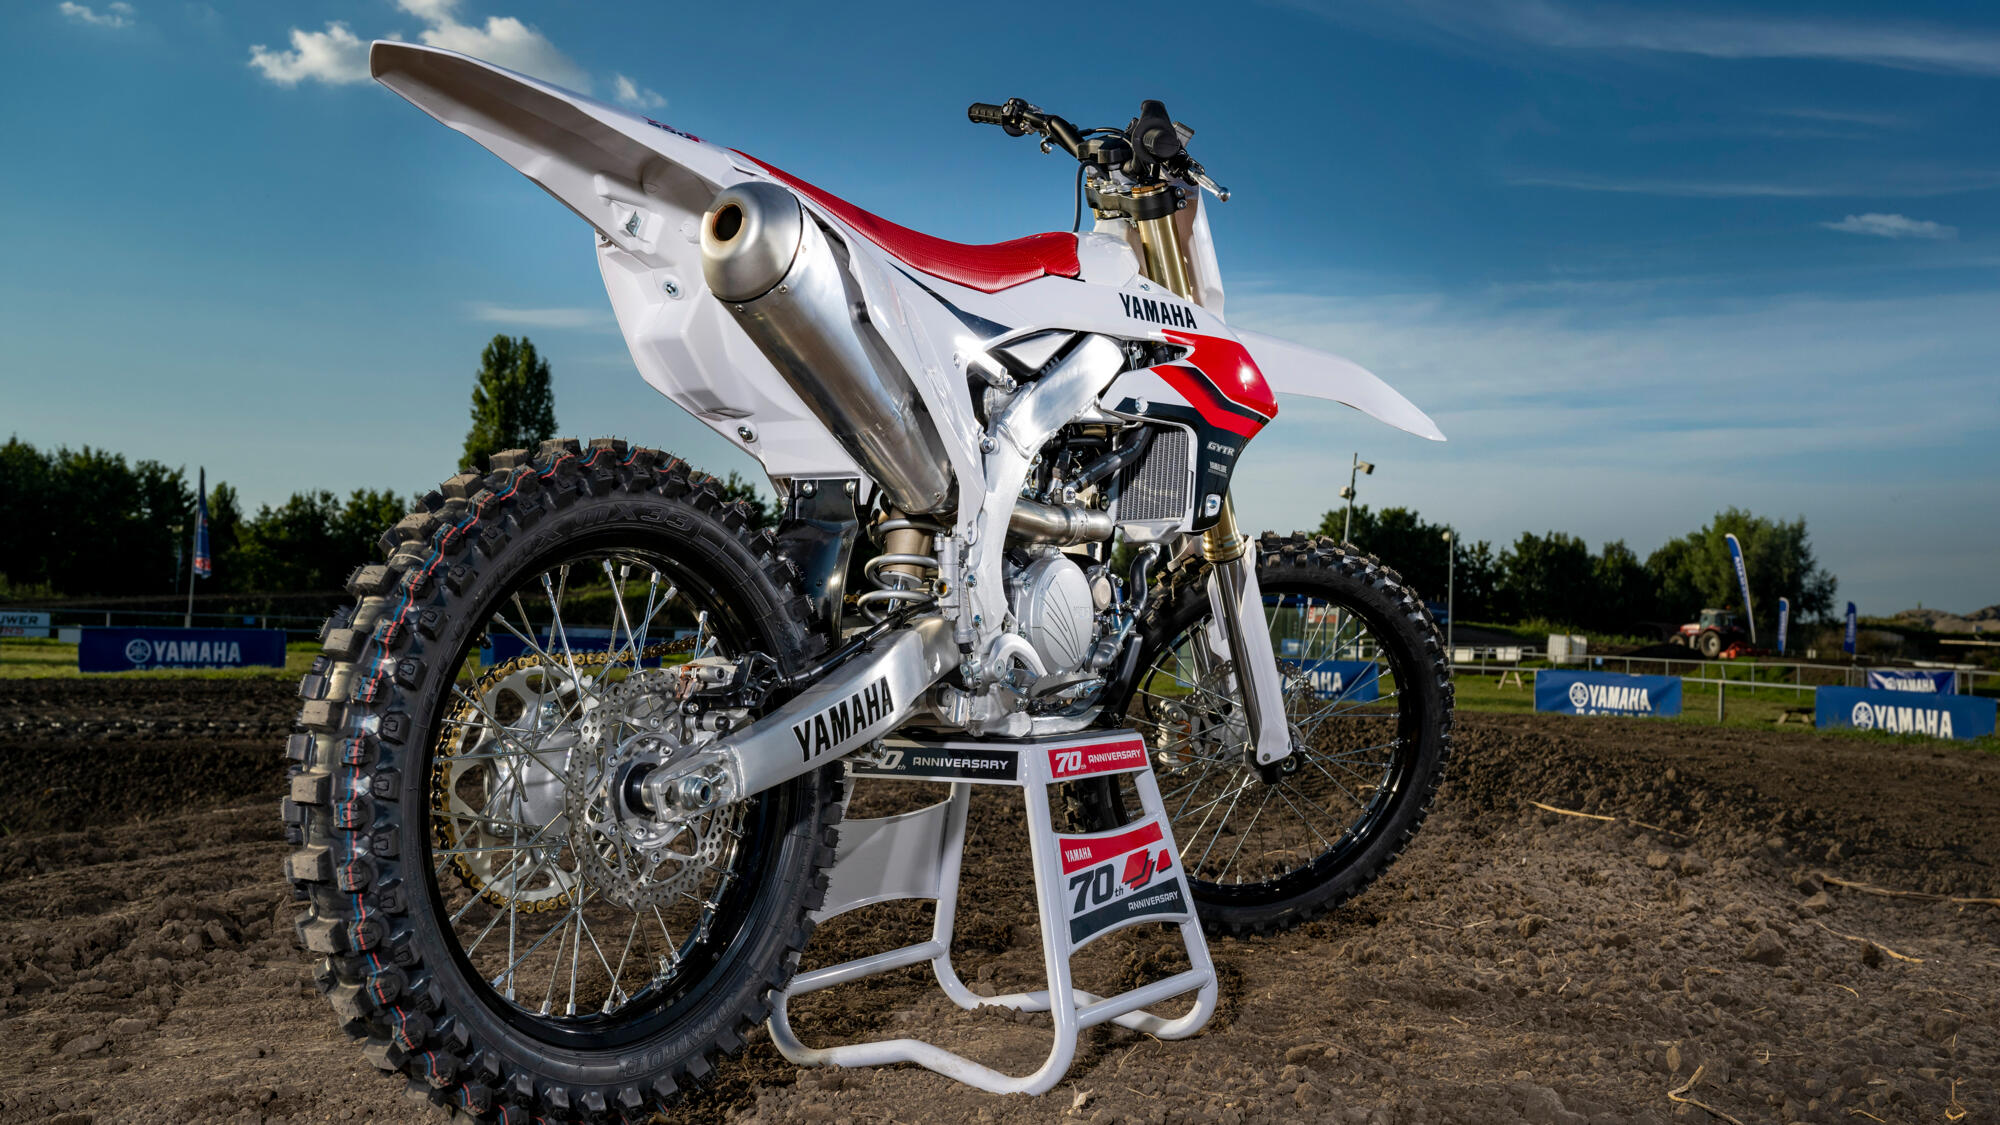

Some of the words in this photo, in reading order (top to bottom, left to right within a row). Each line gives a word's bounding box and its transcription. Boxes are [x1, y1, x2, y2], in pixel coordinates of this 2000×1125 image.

[1119, 292, 1198, 330] YAMAHA
[1207, 441, 1235, 456] GYTR
[153, 640, 241, 663] YAMAHA
[1896, 678, 1938, 693] YAMAHA
[1588, 684, 1652, 711] YAMAHA
[792, 675, 894, 763] YAMAHA
[1874, 704, 1954, 739] YAMAHA
[912, 756, 1008, 770] ANNIVERSARY
[1087, 749, 1141, 764] ANNIVERSARY
[1064, 846, 1093, 863] YAMAHA
[1127, 890, 1179, 912] ANNIVERSARY
